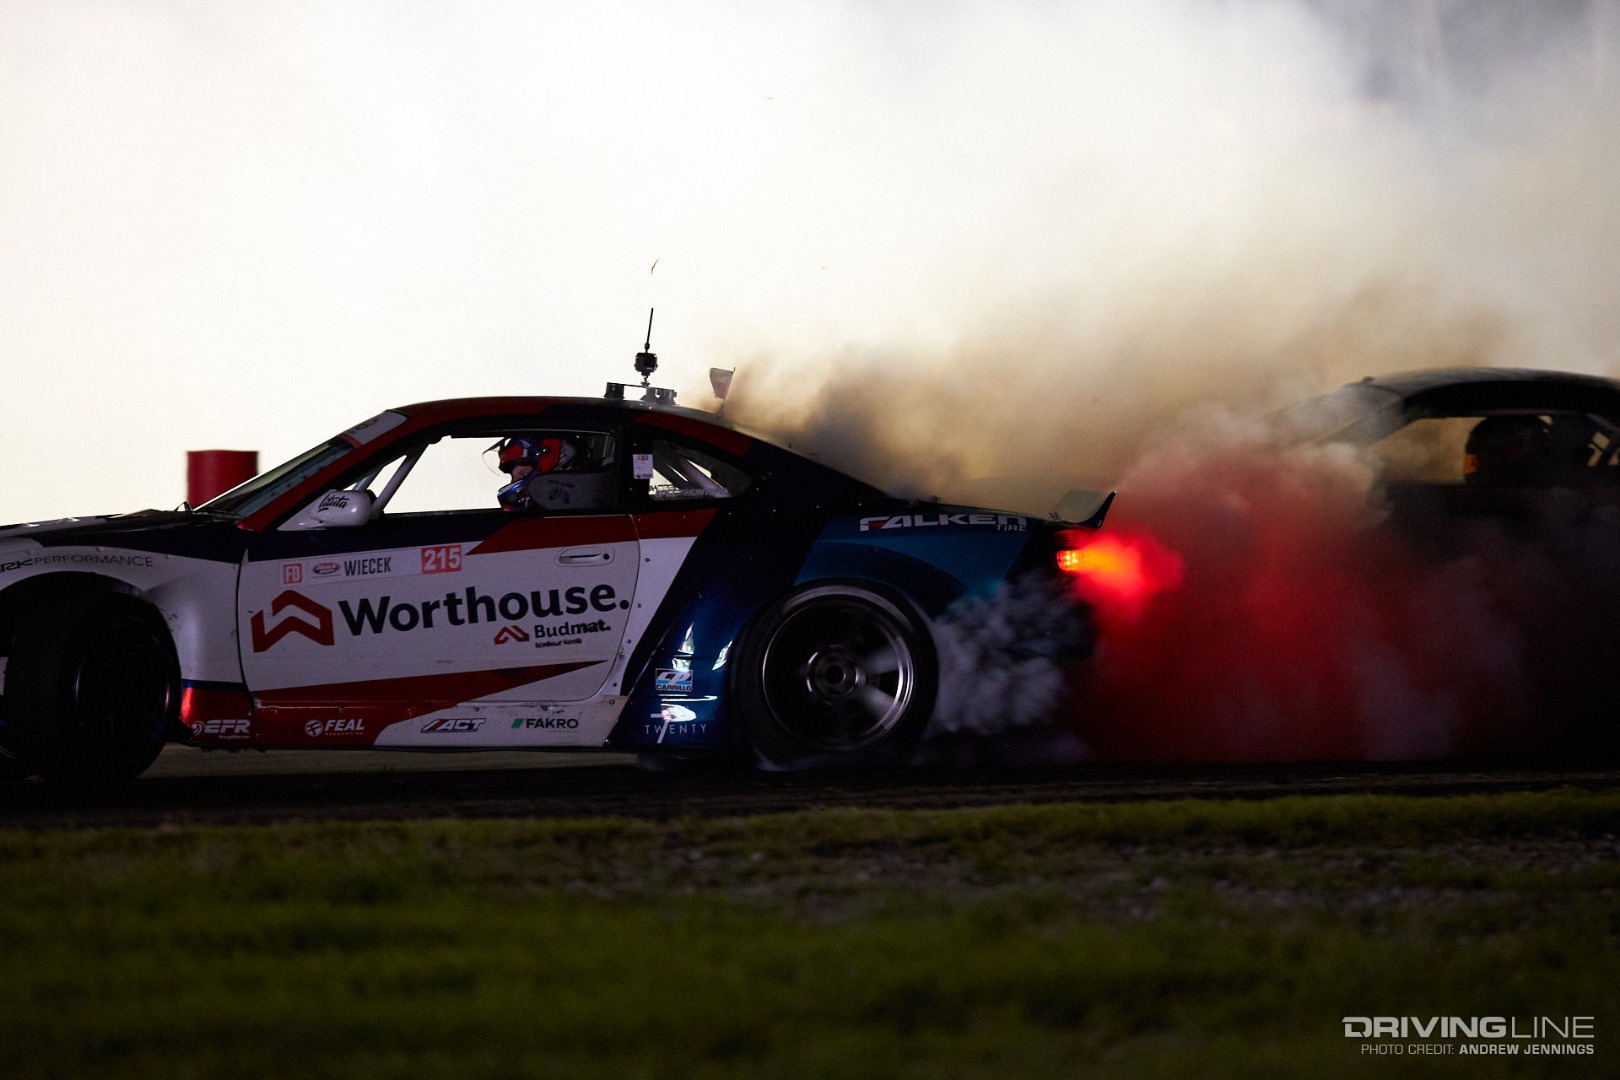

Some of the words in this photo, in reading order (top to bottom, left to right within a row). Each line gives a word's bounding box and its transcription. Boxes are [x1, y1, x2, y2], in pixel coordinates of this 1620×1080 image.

[859, 513, 1027, 532] FALKEN
[344, 557, 391, 576] WIECEK
[424, 547, 462, 571] 215
[338, 584, 630, 637] Worthouse.
[534, 619, 611, 638] Budmat.
[204, 719, 250, 734] EFR
[325, 719, 365, 731] FEAL
[526, 718, 578, 729] FAKRO
[644, 723, 707, 735] TWENTY
